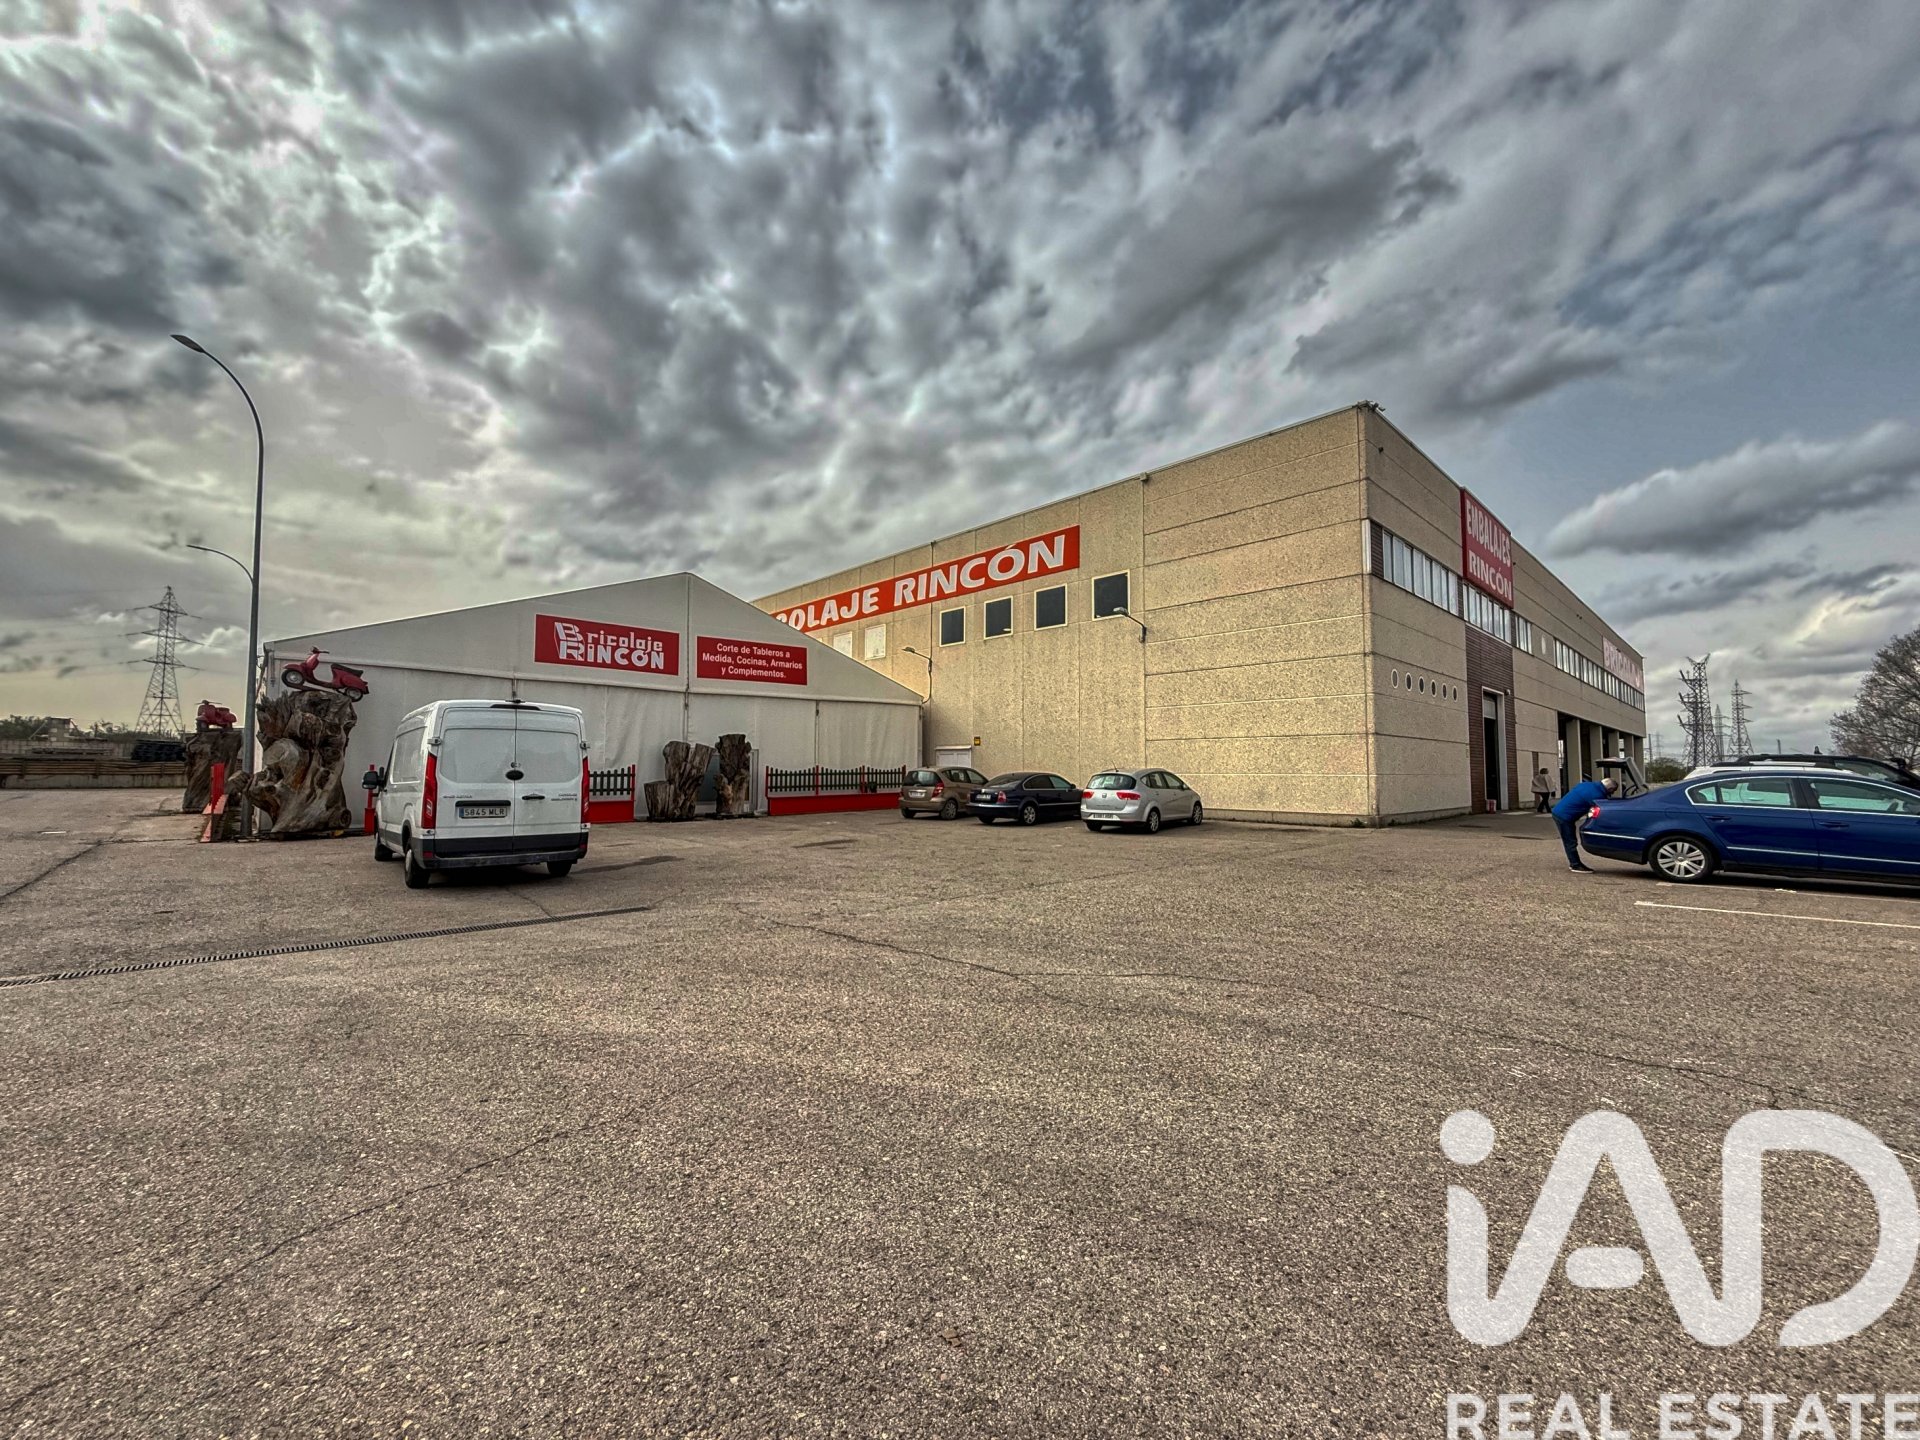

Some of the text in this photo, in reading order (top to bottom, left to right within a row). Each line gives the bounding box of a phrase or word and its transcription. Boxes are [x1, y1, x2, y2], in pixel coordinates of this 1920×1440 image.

[1466, 499, 1511, 568] EMBALAJES
[893, 534, 1066, 607] RINCÓN
[1468, 549, 1512, 601] RINCÓN
[553, 621, 663, 653] Bricolaje
[702, 652, 803, 669] Medida, Cocinas, Armarios
[716, 643, 739, 653] Corte
[740, 646, 751, 654] de
[752, 646, 784, 658] Tableros
[721, 665, 787, 678] y Complementos.
[464, 808, 487, 816] 5845
